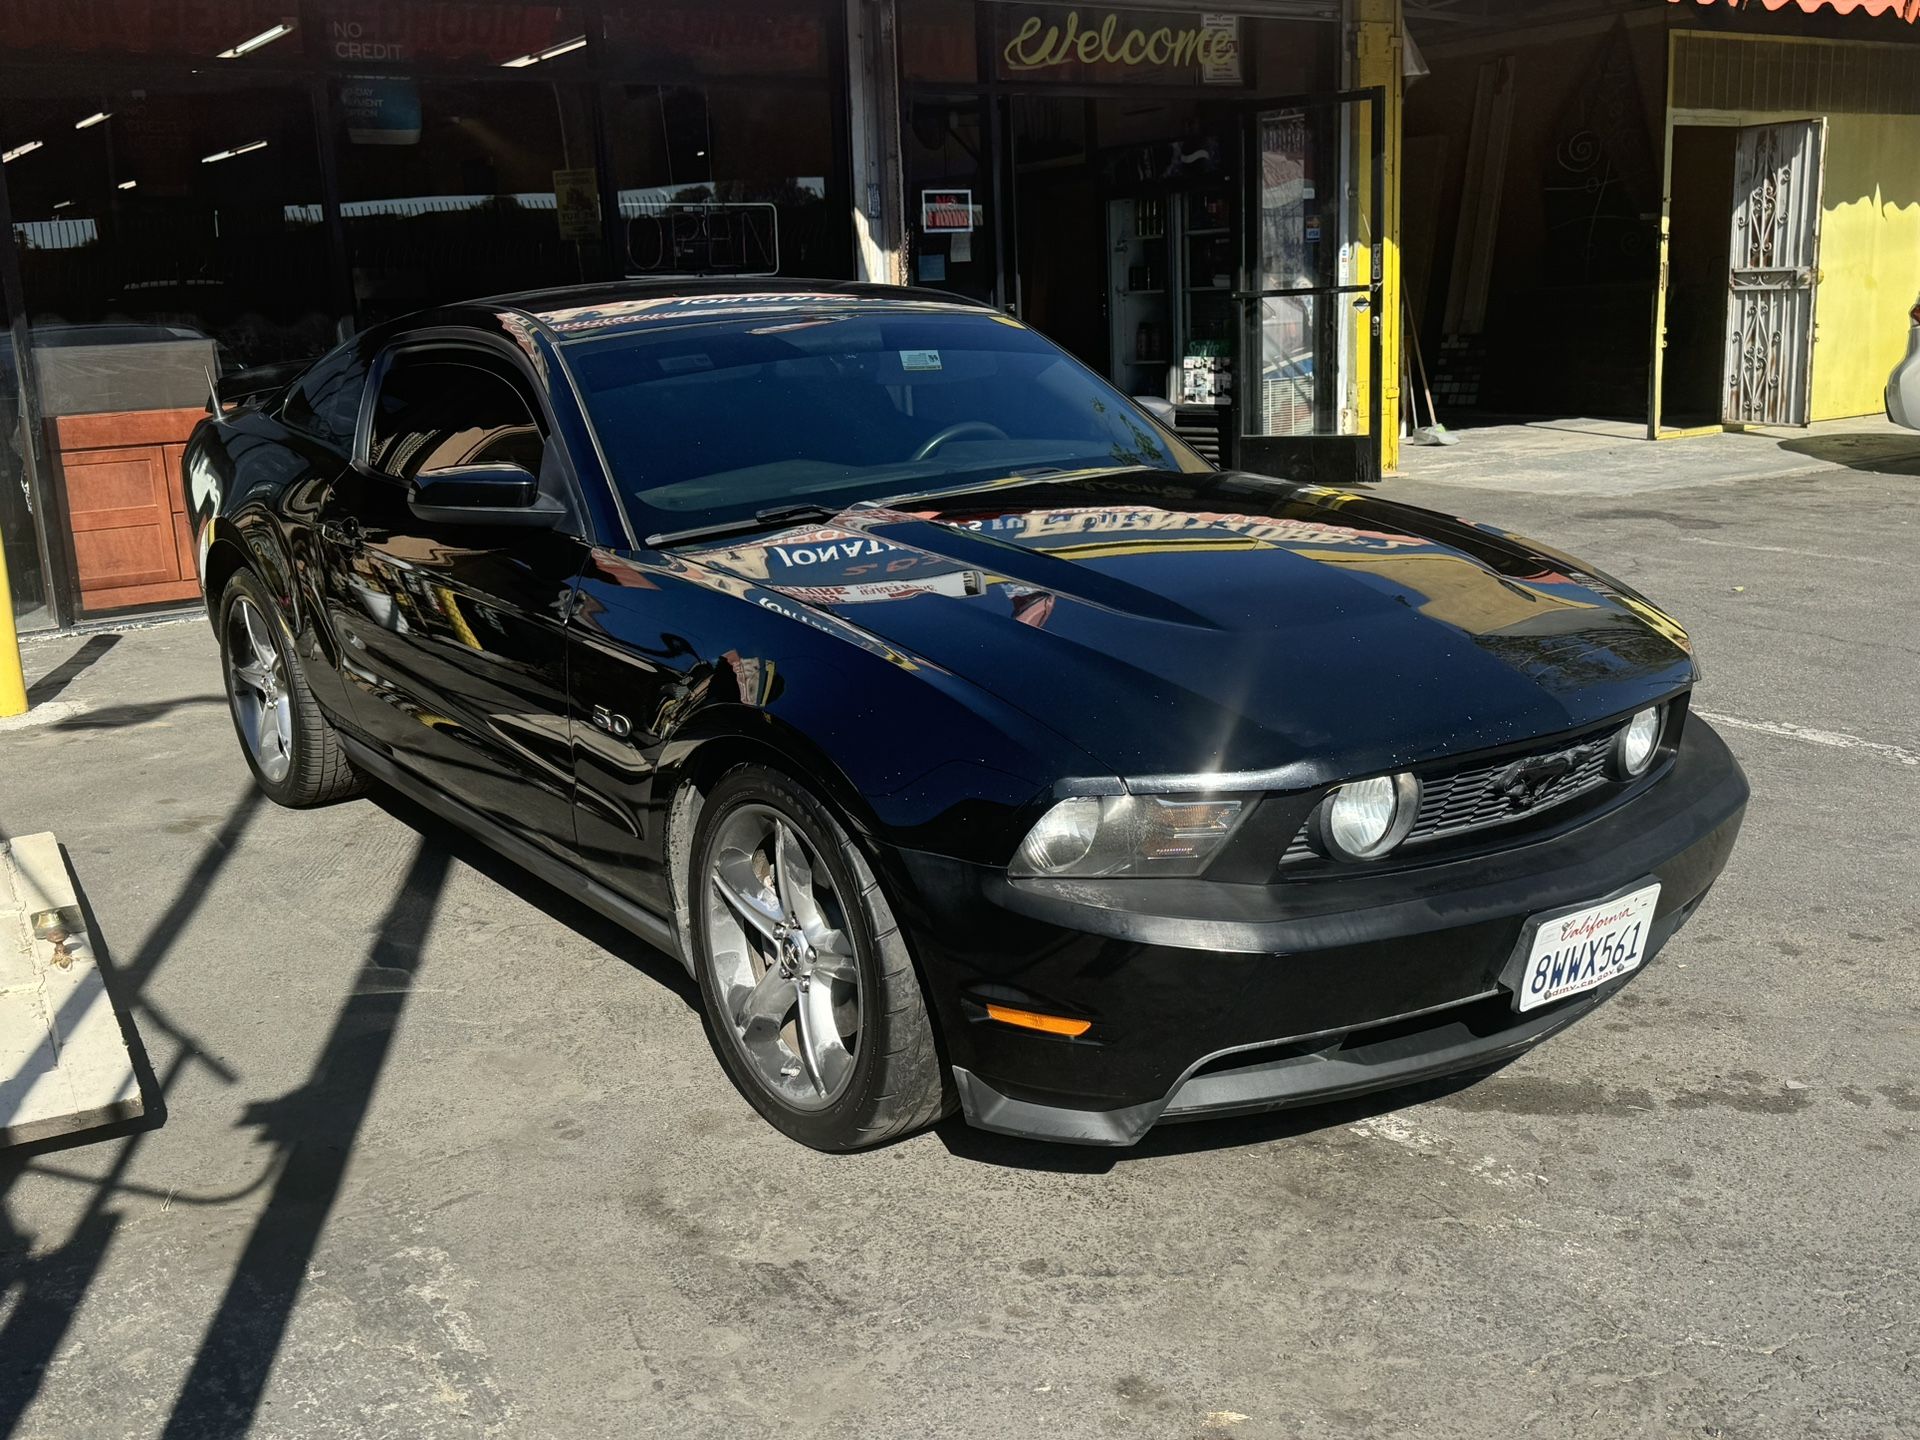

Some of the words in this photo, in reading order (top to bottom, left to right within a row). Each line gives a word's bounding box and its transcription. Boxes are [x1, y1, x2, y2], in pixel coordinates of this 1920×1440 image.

[333, 20, 363, 39] NO
[335, 42, 404, 60] CREDIT
[1004, 11, 1234, 70] Welcome
[626, 211, 775, 271] OPEN
[1560, 906, 1636, 942] California
[1531, 921, 1642, 994] 8WWX561
